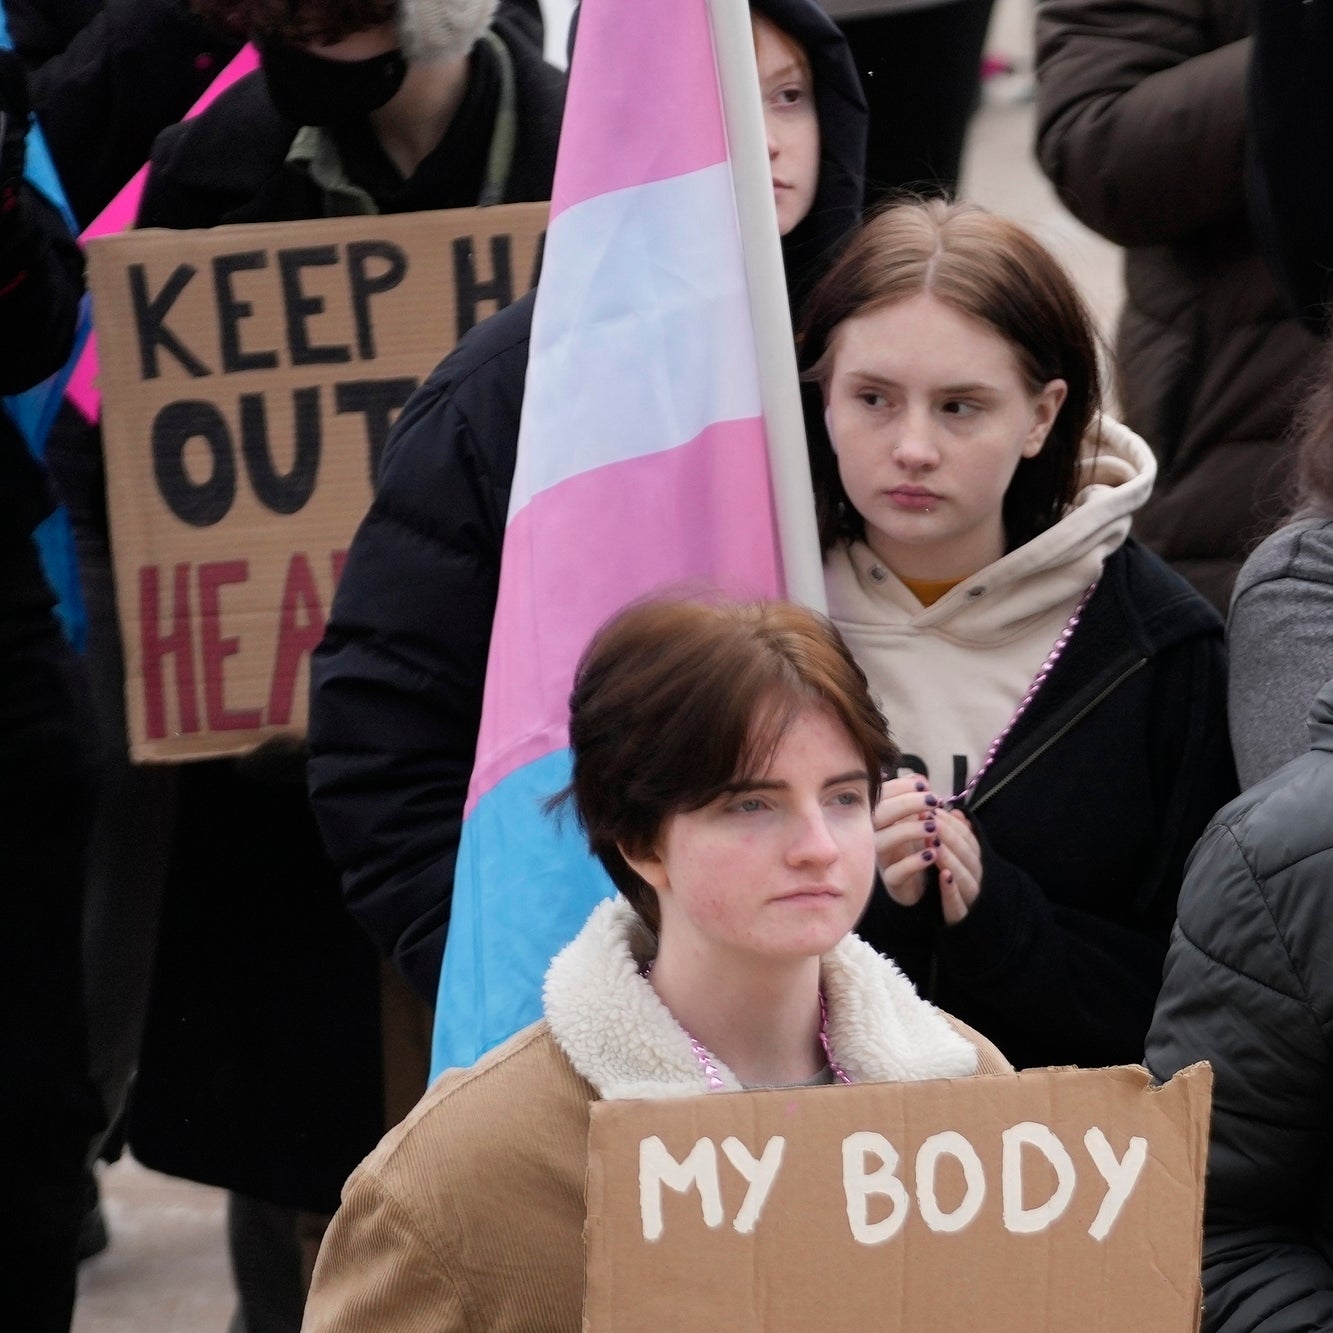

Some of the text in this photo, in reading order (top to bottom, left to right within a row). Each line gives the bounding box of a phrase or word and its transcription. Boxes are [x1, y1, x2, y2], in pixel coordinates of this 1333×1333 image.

[127, 232, 545, 380] KEEP H
[151, 376, 420, 528] OUT
[138, 548, 350, 740] HEA
[638, 1120, 1149, 1245] MY BODY
